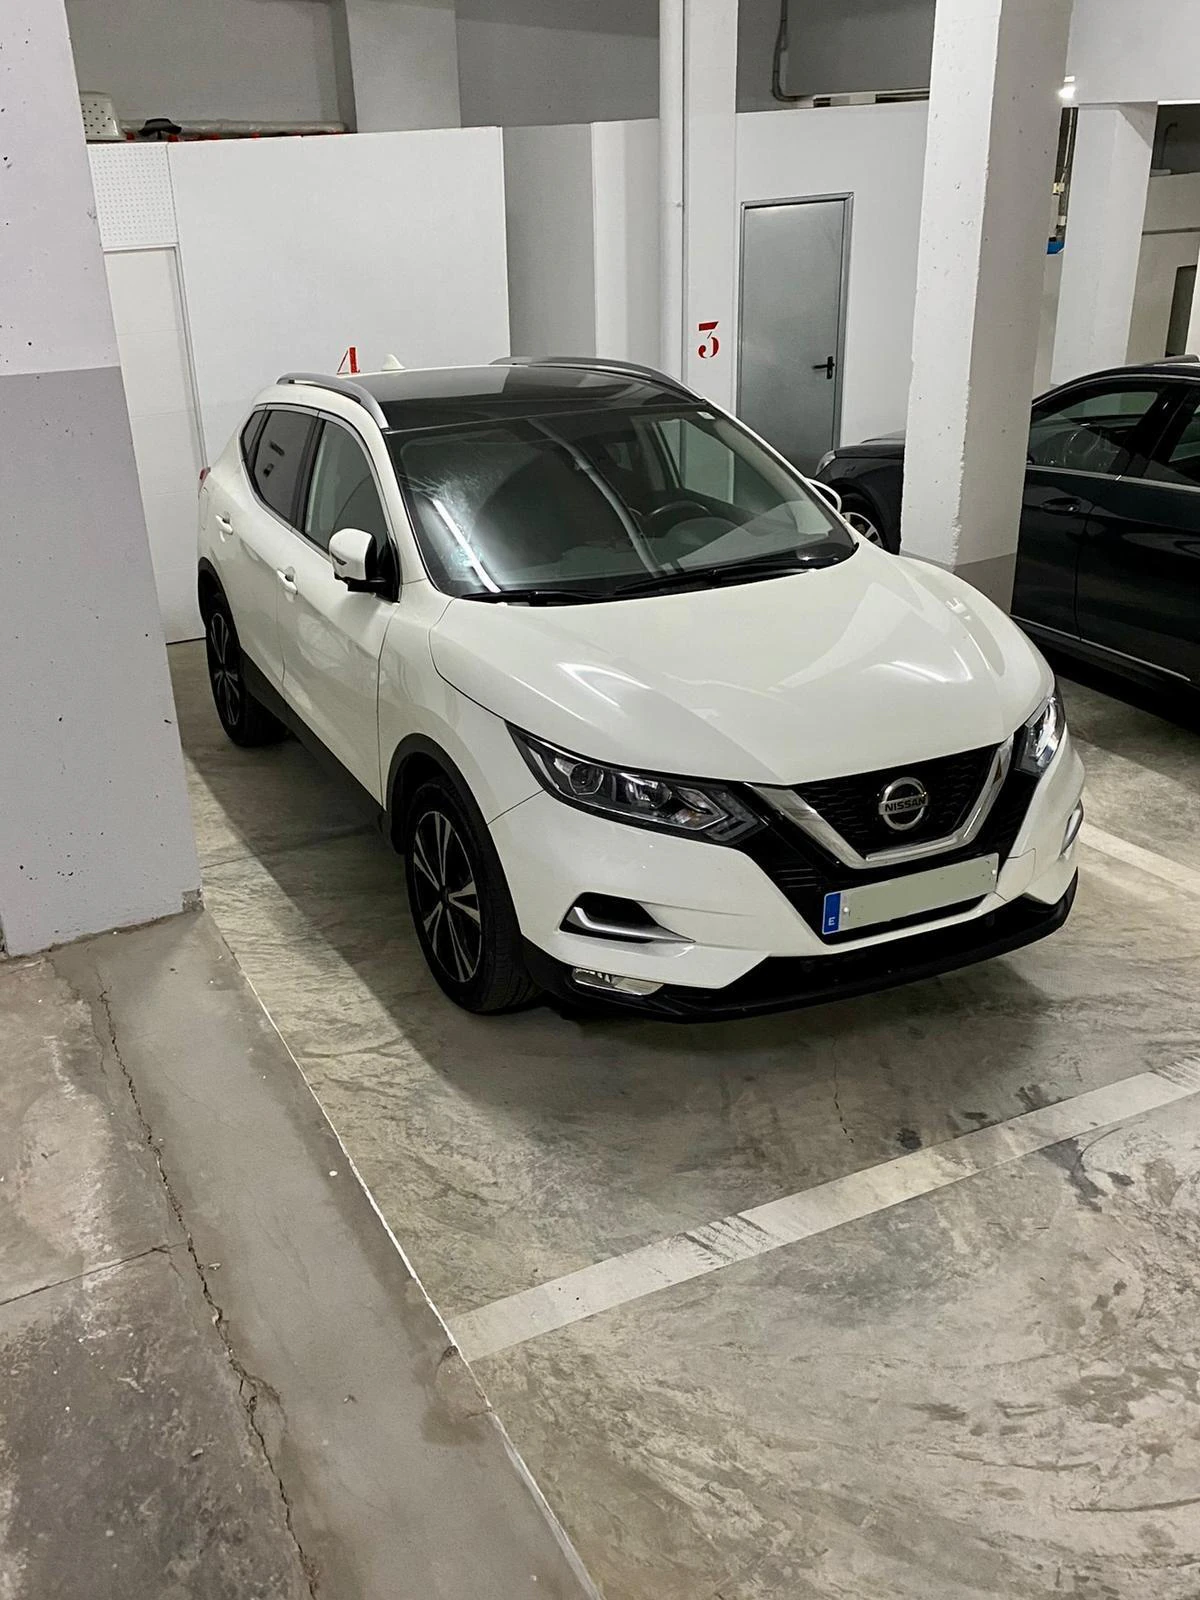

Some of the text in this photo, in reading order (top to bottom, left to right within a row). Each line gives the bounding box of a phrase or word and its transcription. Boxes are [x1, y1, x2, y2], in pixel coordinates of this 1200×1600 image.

[698, 321, 719, 359] 3
[884, 798, 926, 812] NISSAN
[828, 917, 835, 926] E
